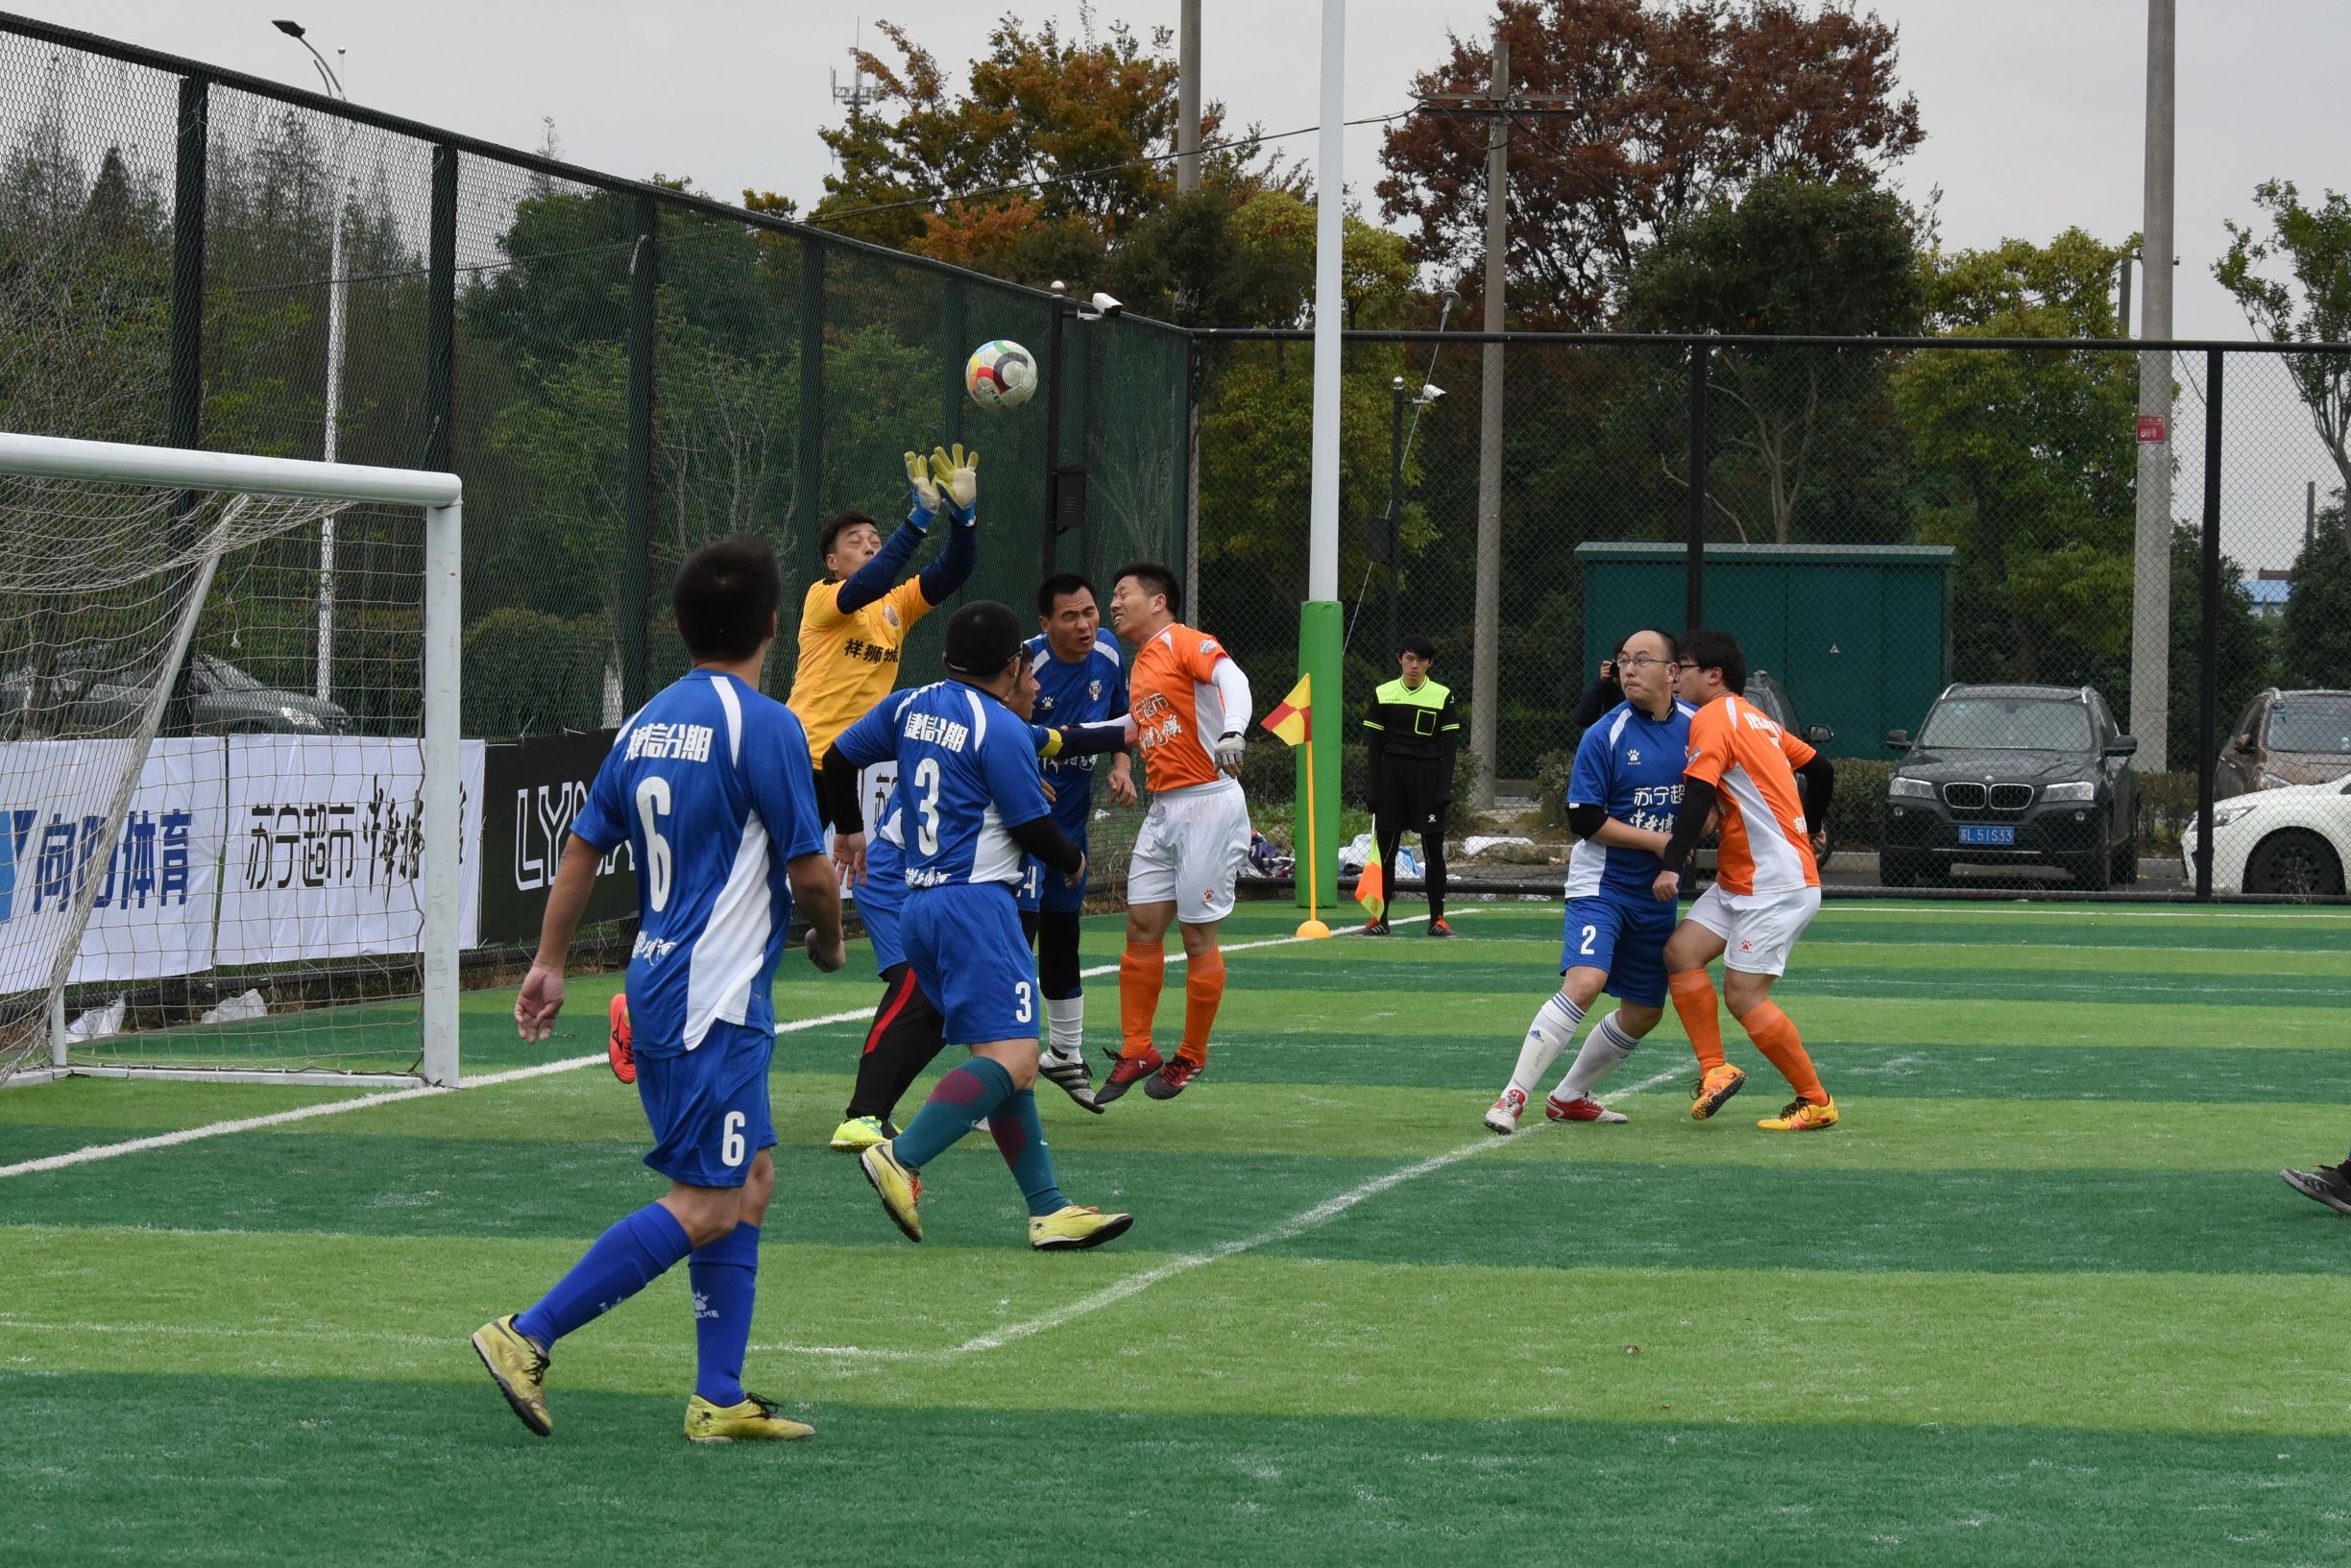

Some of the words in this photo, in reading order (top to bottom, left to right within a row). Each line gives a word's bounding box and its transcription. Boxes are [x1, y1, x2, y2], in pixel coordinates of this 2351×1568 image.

[914, 758, 940, 856] 3
[636, 776, 671, 912] 6
[1581, 925, 1596, 955] 2
[1015, 981, 1031, 1024] 3
[721, 1110, 745, 1167] 6
